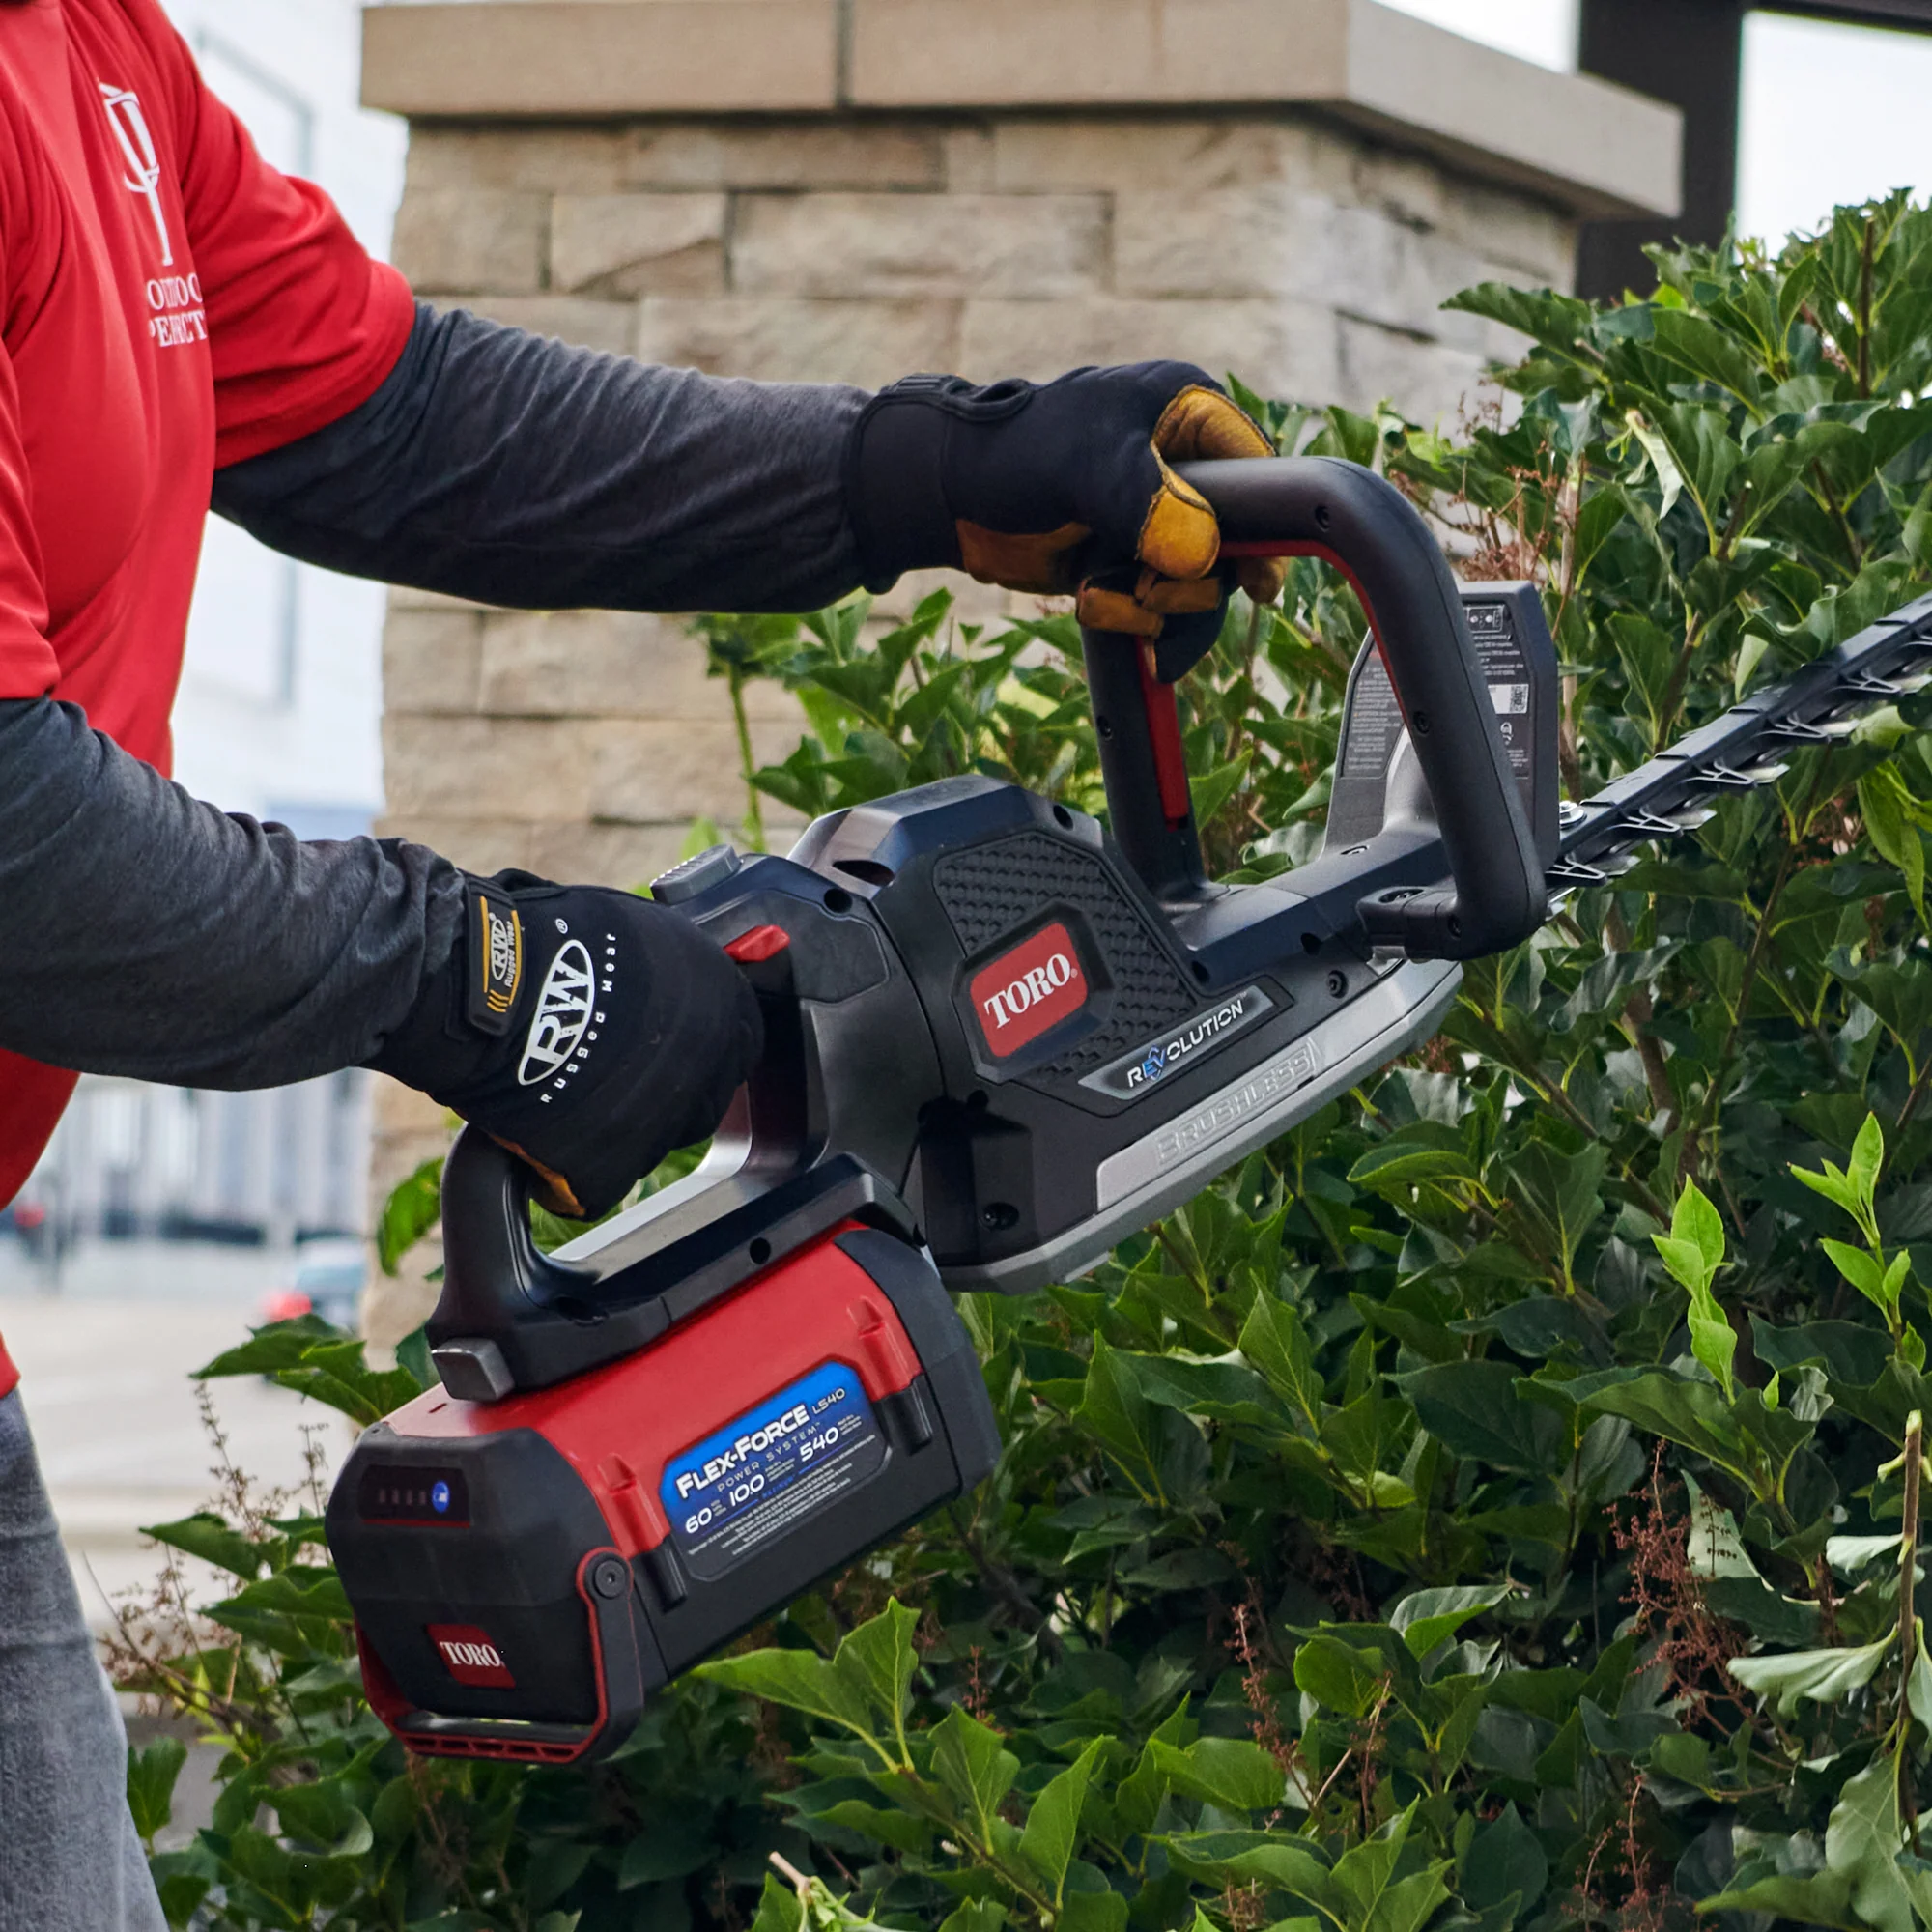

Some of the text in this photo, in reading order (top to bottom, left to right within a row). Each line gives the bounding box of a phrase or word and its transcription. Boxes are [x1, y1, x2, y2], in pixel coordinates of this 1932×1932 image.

[528, 958, 591, 1066] RW
[540, 933, 617, 1103] Rugged Wear
[983, 953, 1072, 1029] TORO
[1157, 1043, 1312, 1160] BRUSHLESS
[676, 1404, 810, 1499] FLEX-FORCE
[811, 1387, 846, 1415] L540
[685, 1507, 713, 1534] 60
[729, 1474, 765, 1507] 10.0
[800, 1427, 839, 1463] 540
[717, 1461, 760, 1492] POWER
[440, 1641, 500, 1667] TORO
